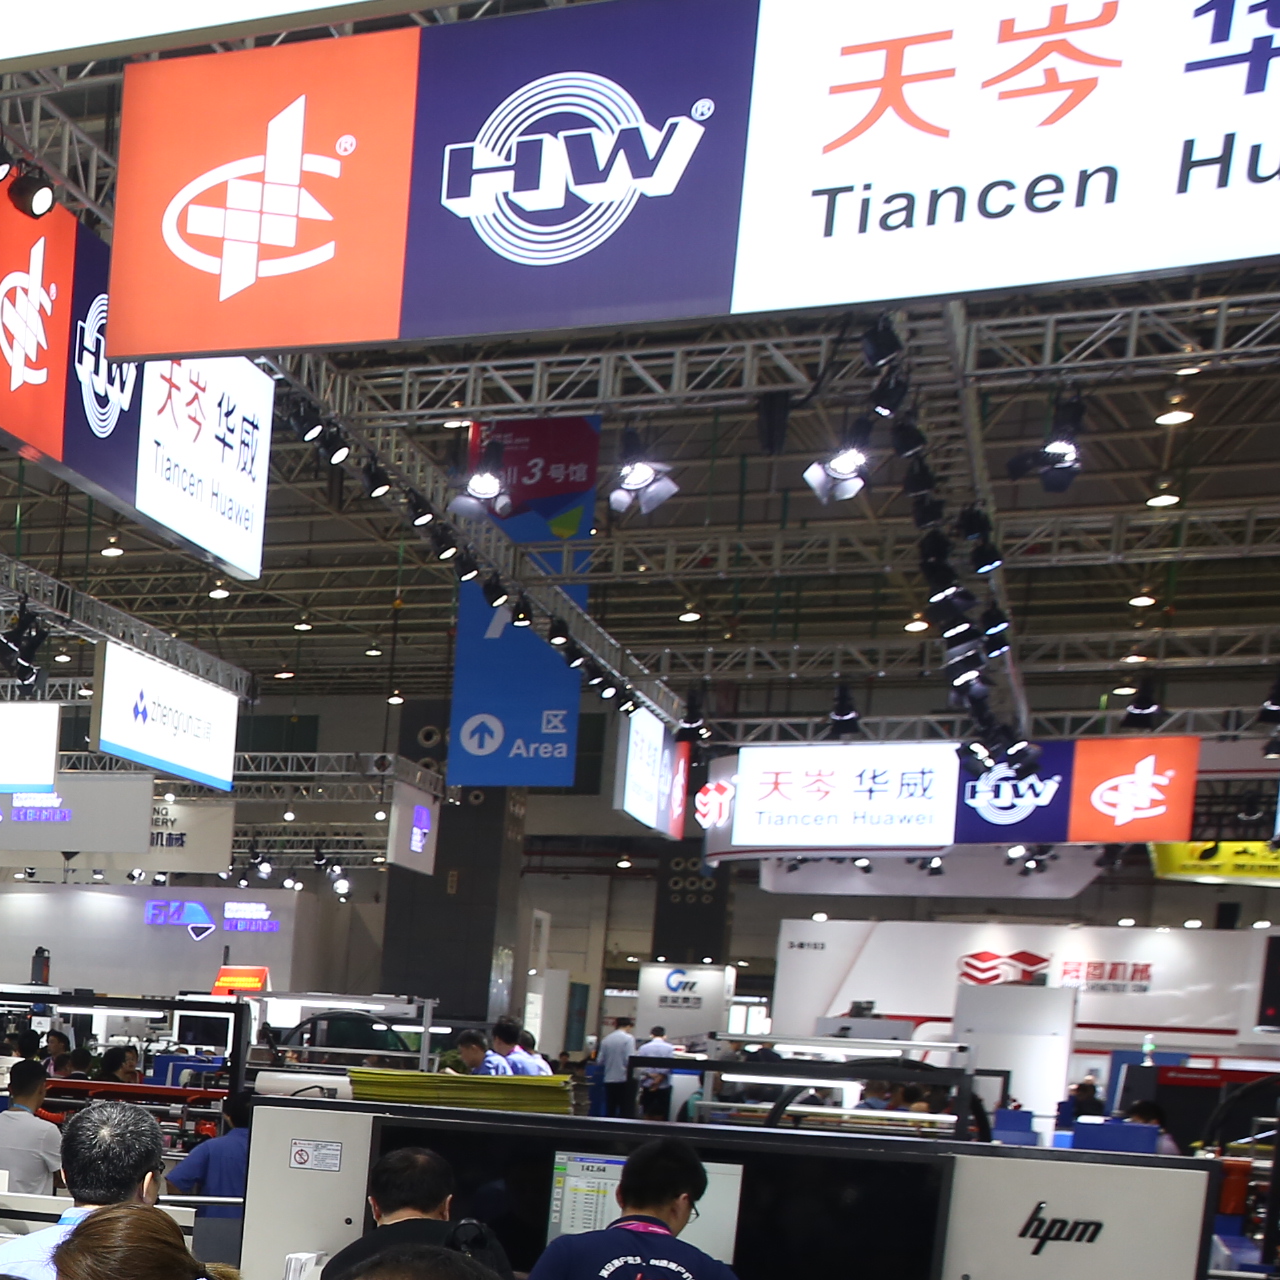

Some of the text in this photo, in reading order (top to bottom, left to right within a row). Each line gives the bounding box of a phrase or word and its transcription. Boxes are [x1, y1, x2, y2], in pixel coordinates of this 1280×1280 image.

[811, 165, 1119, 238] Tiancen
[154, 439, 255, 533] Tiancen Huawei
[508, 738, 567, 758] Area
[755, 810, 935, 826] Tiancen Huawei
[1018, 1201, 1104, 1256] hpm
